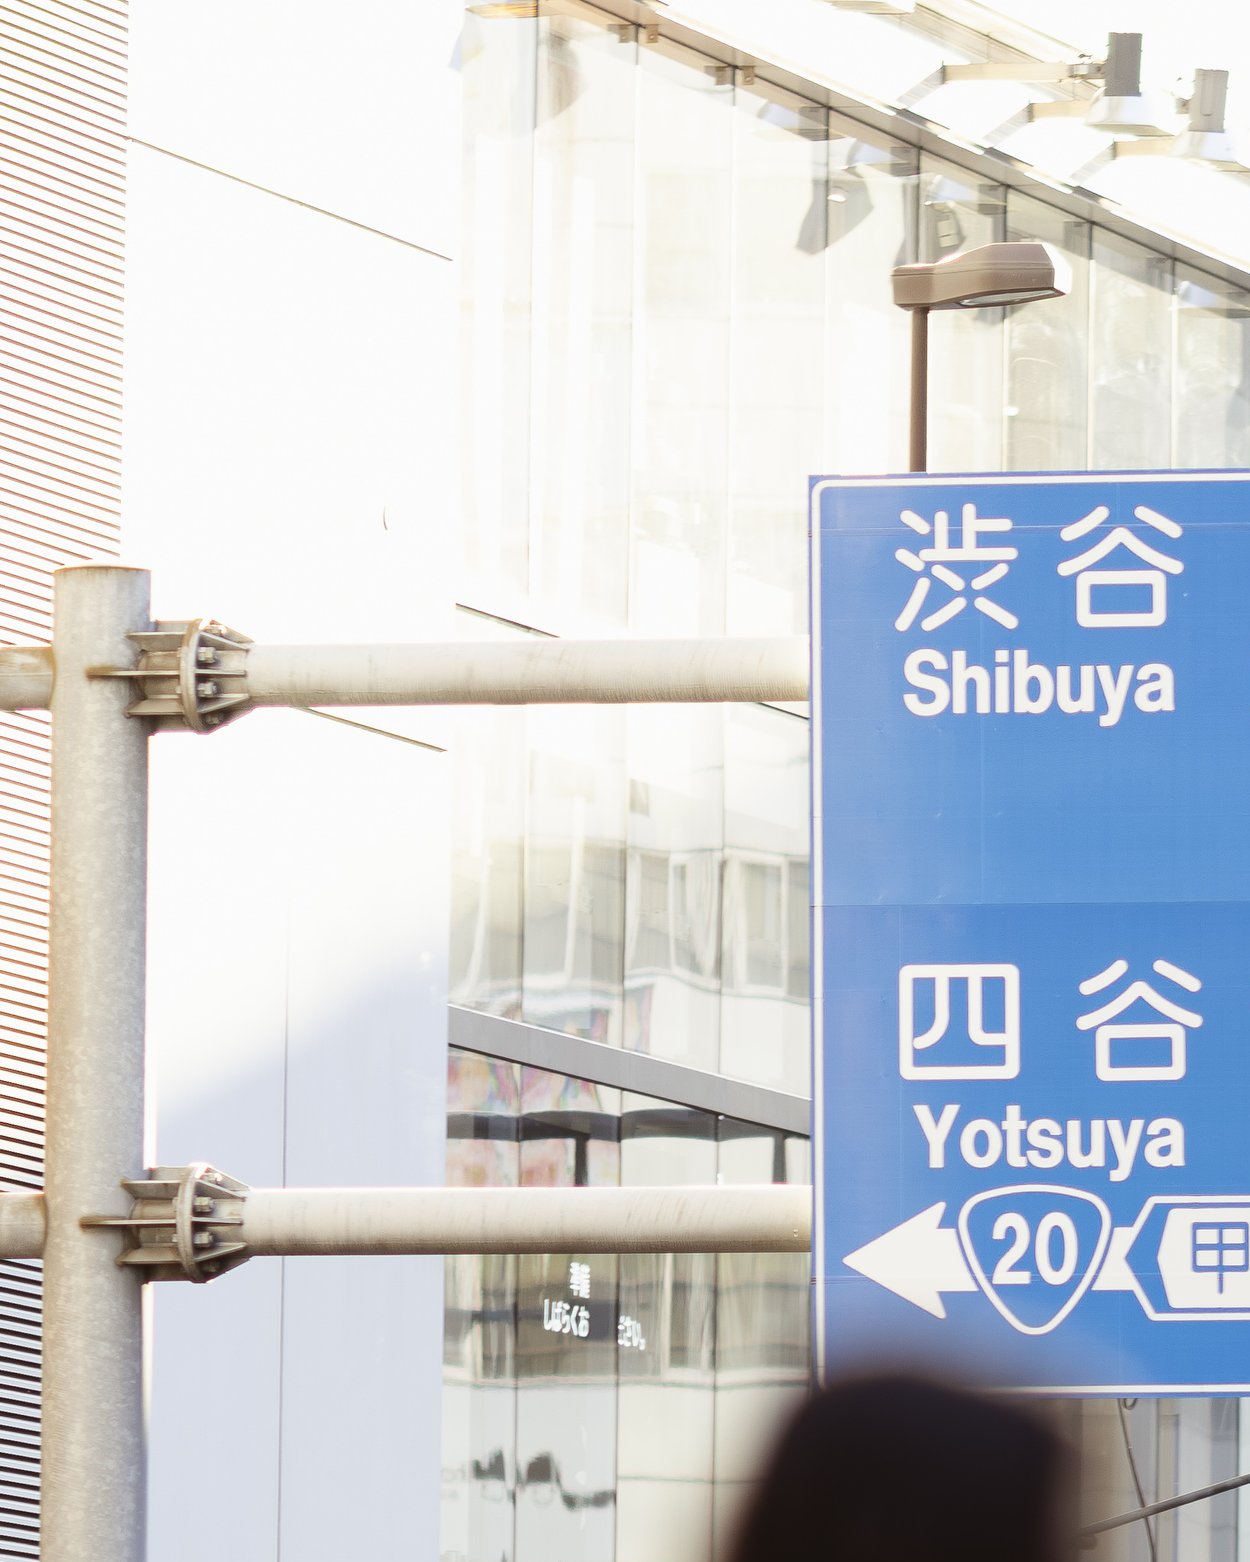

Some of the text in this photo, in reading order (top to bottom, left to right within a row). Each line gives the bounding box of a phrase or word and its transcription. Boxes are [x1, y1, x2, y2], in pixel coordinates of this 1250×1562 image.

[895, 503, 1184, 631] 渋谷
[903, 649, 1175, 726] Shibuya
[899, 960, 1203, 1081] 四谷
[913, 1104, 1186, 1182] Yotsuya
[992, 1211, 1079, 1286] 20
